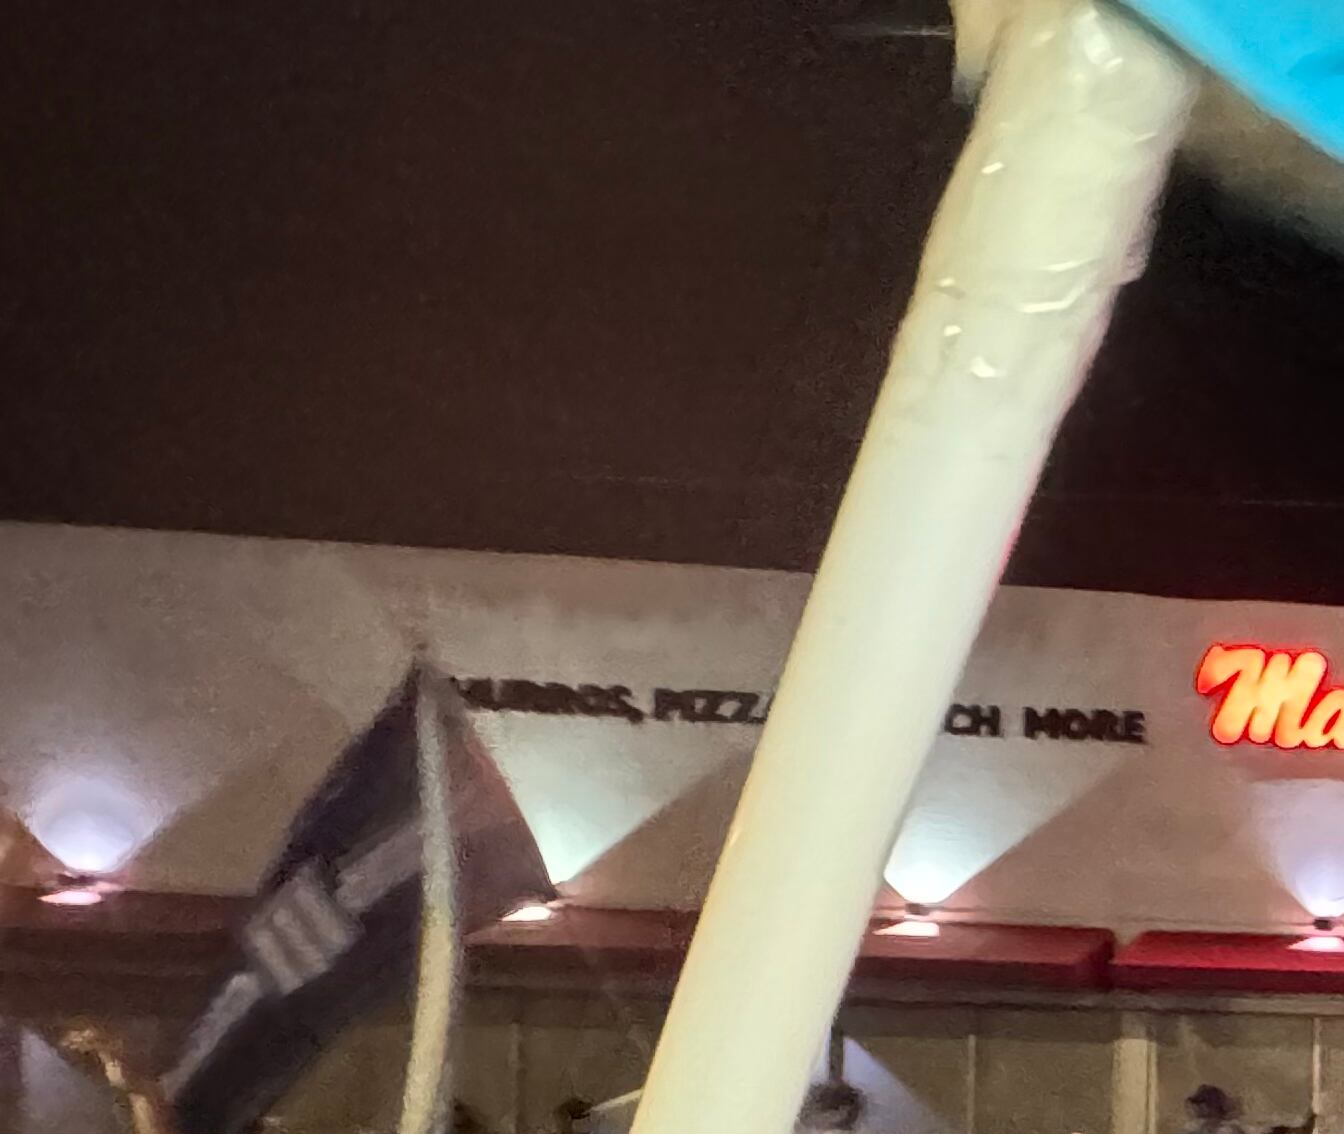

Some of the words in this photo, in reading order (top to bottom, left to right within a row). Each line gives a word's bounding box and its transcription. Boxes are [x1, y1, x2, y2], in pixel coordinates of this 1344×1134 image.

[654, 687, 768, 724] PIZZ
[944, 703, 1003, 738] CH
[1023, 706, 1147, 744] MORE
